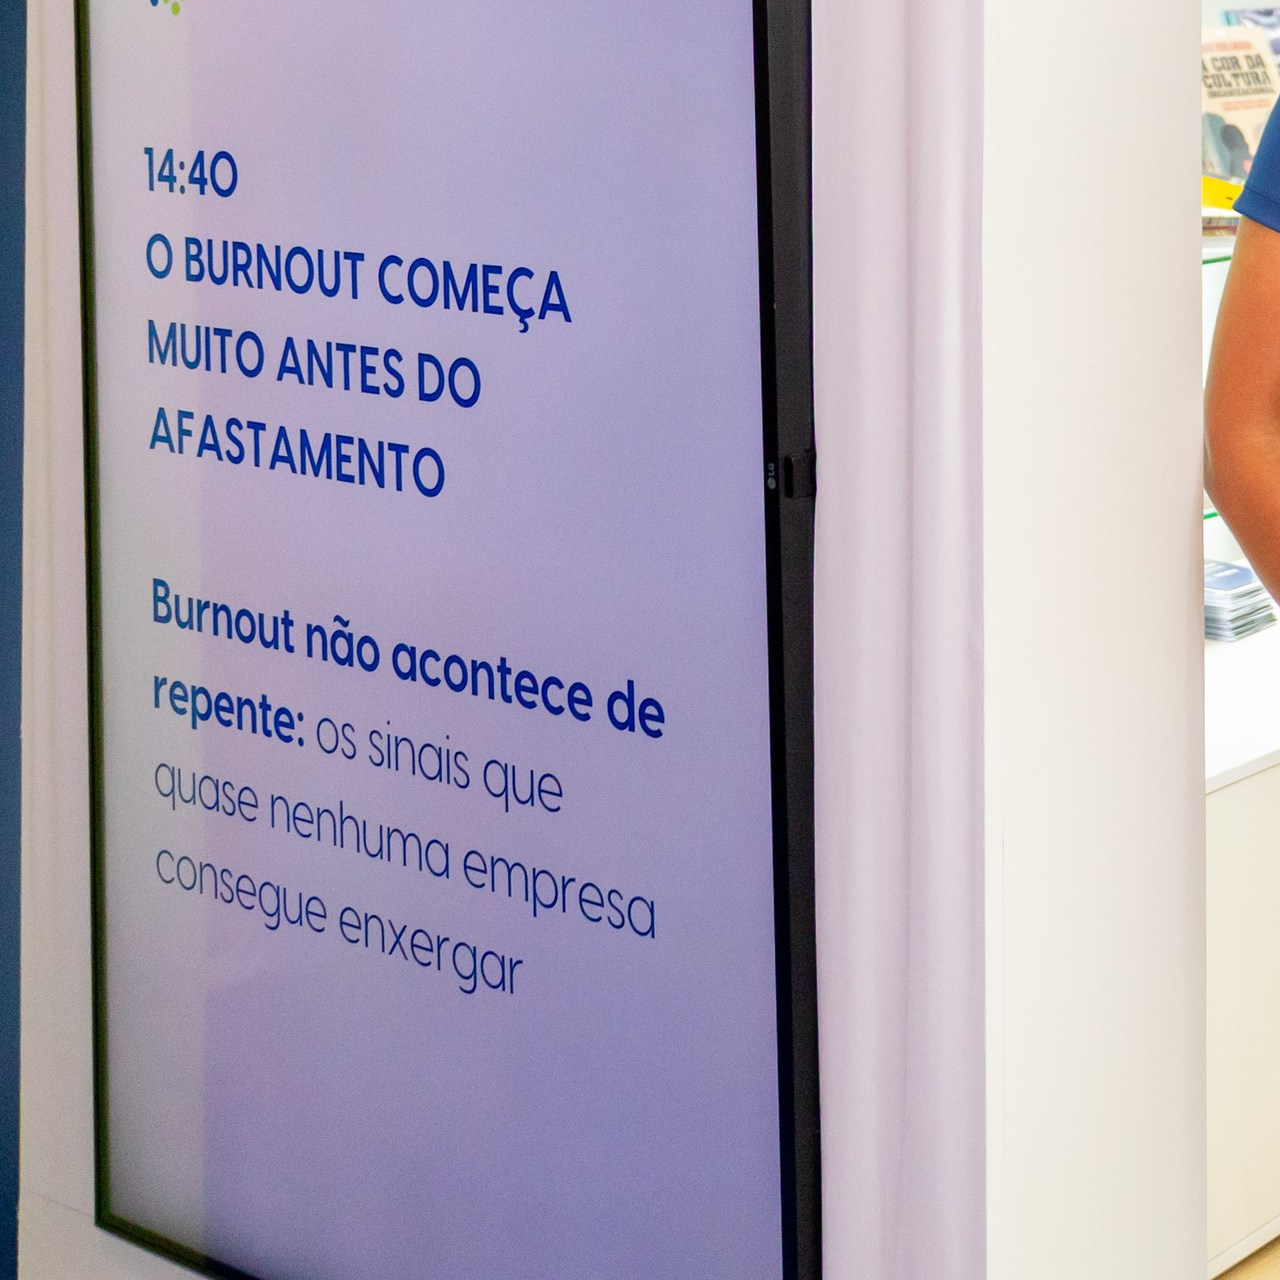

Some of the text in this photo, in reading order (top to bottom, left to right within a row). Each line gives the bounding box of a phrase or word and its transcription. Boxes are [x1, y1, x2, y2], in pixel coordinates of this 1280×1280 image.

[1202, 71, 1271, 89] CULTURA
[1211, 56, 1241, 71] COR
[1244, 54, 1266, 69] DA
[144, 147, 238, 198] 14:40
[146, 233, 572, 333] O BURNOUT COMEÇA
[147, 319, 482, 408] MUITO ANTES DO
[149, 406, 445, 498] AFASTAMENTO
[152, 578, 665, 738] Burnout não acontece de
[153, 675, 563, 813] repente: os sinais que
[154, 763, 656, 939] quase nenhuma empresa
[156, 849, 523, 995] consegue enxergar
